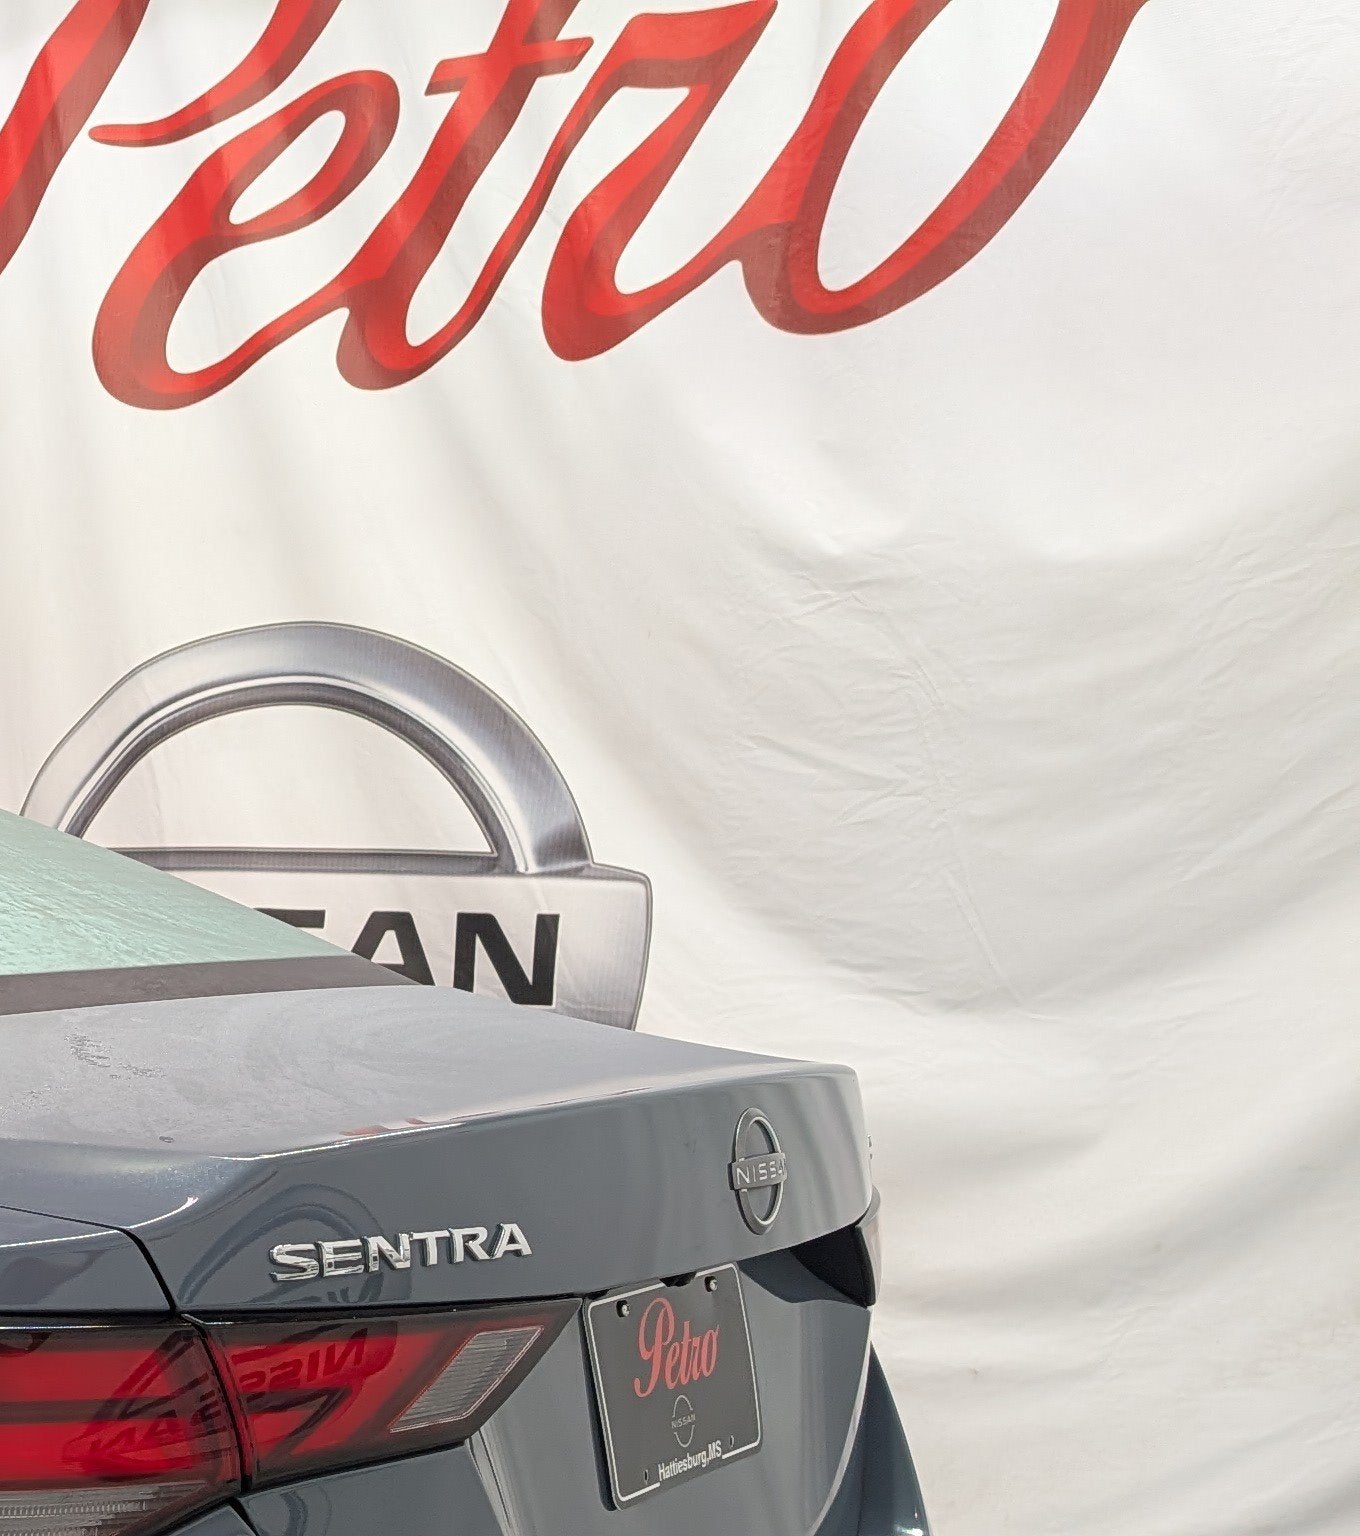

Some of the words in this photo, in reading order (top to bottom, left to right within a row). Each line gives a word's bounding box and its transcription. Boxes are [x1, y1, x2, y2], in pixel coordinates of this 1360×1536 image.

[268, 1222, 534, 1282] SENTRA
[633, 1297, 720, 1398] Petro
[671, 1413, 697, 1430] NISSAN
